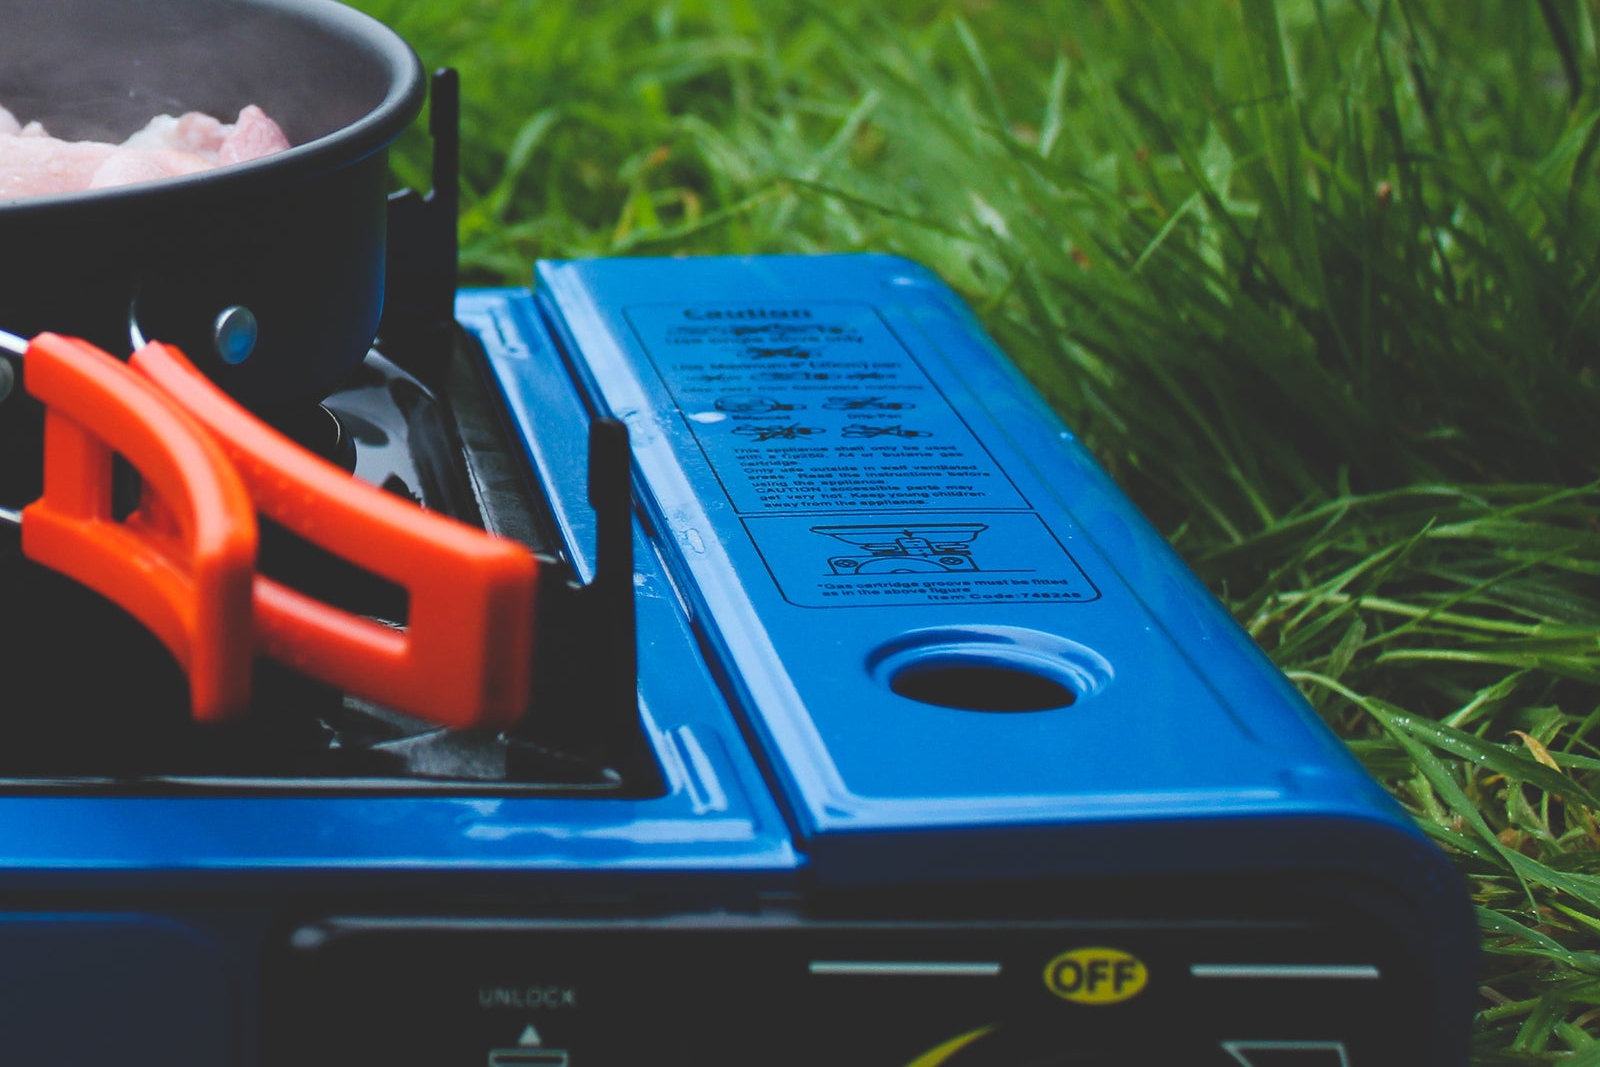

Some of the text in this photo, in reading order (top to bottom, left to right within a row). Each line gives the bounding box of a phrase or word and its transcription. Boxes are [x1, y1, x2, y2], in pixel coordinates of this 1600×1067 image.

[684, 309, 812, 320] Caution
[940, 451, 964, 459] gas
[751, 480, 788, 488] using
[760, 494, 781, 502] get
[786, 493, 815, 501] very
[850, 491, 885, 499] Keep
[888, 491, 929, 499] young
[763, 501, 798, 509] away
[856, 580, 919, 589] cartridge
[922, 579, 971, 588] groove
[884, 587, 927, 595] above
[929, 587, 971, 595] figure
[1052, 958, 1137, 995] OFF
[478, 986, 578, 1007] UNLOCK
